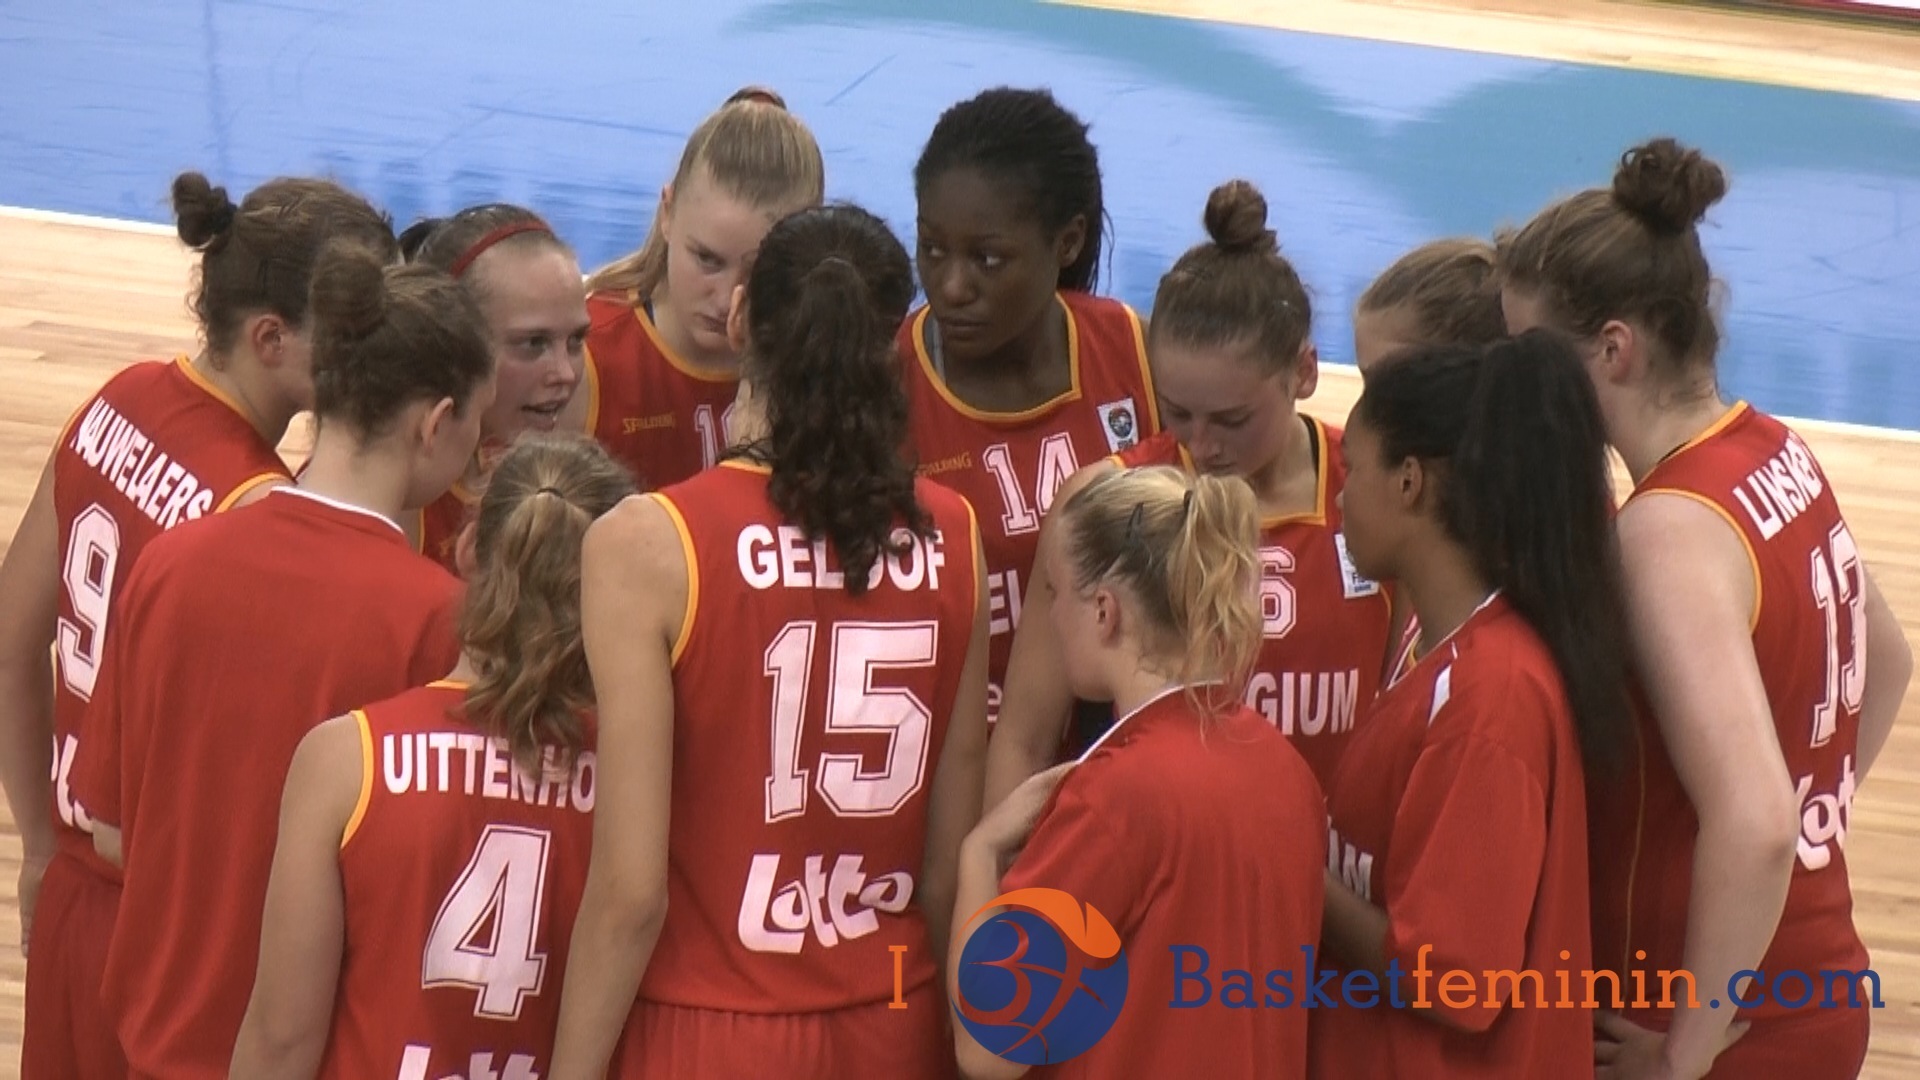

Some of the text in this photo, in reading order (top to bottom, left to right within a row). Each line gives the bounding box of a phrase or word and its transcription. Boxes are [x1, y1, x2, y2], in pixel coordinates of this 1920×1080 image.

[737, 523, 945, 591] GELOF
[983, 432, 1080, 537] 14
[57, 502, 119, 703] 9
[1258, 546, 1297, 639] 6
[1810, 520, 1868, 749] 13
[764, 620, 939, 824] 15
[421, 824, 552, 1021] 4
[738, 853, 914, 954] Lotto
